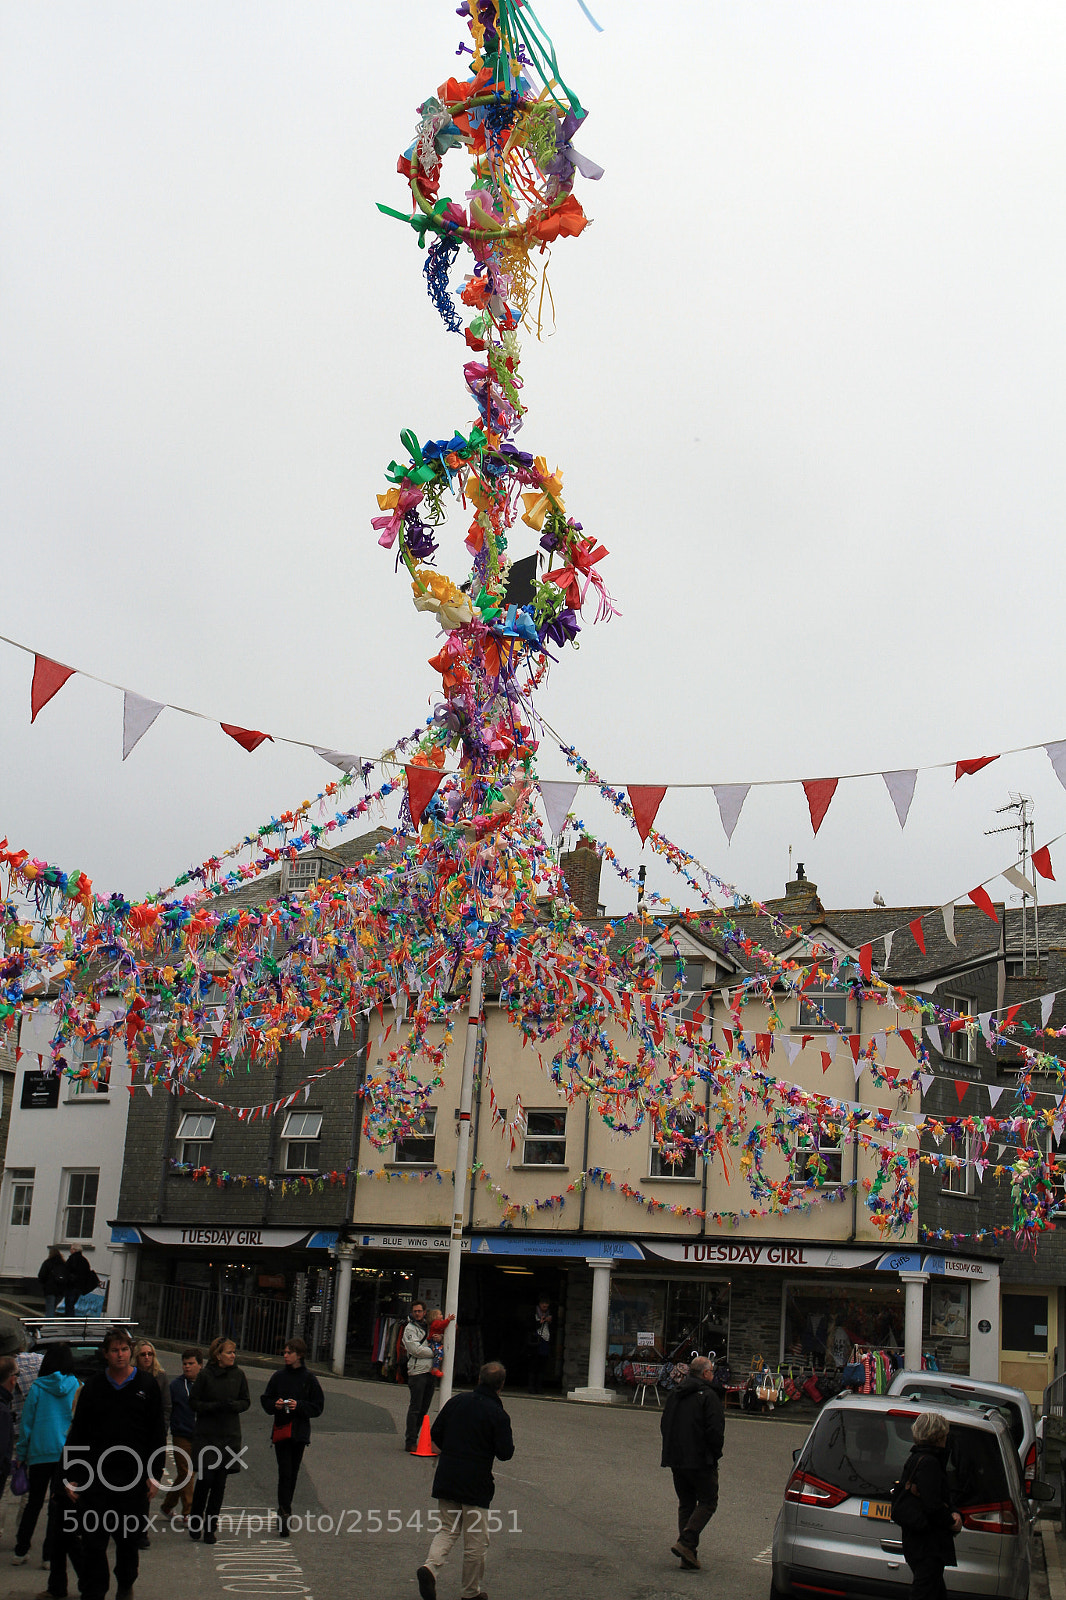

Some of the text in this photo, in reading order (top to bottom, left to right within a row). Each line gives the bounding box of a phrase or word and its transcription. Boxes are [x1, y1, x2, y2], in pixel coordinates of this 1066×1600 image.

[181, 1229, 263, 1246] TUESDAY GIRL
[382, 1237, 469, 1248] BLUE WING GALRY
[682, 1243, 808, 1265] TUESDAY GIRL
[889, 1254, 911, 1270] Gifts
[945, 1261, 971, 1273] TUESDAY
[970, 1264, 984, 1274] GIRL
[212, 1539, 314, 1600] OADING
